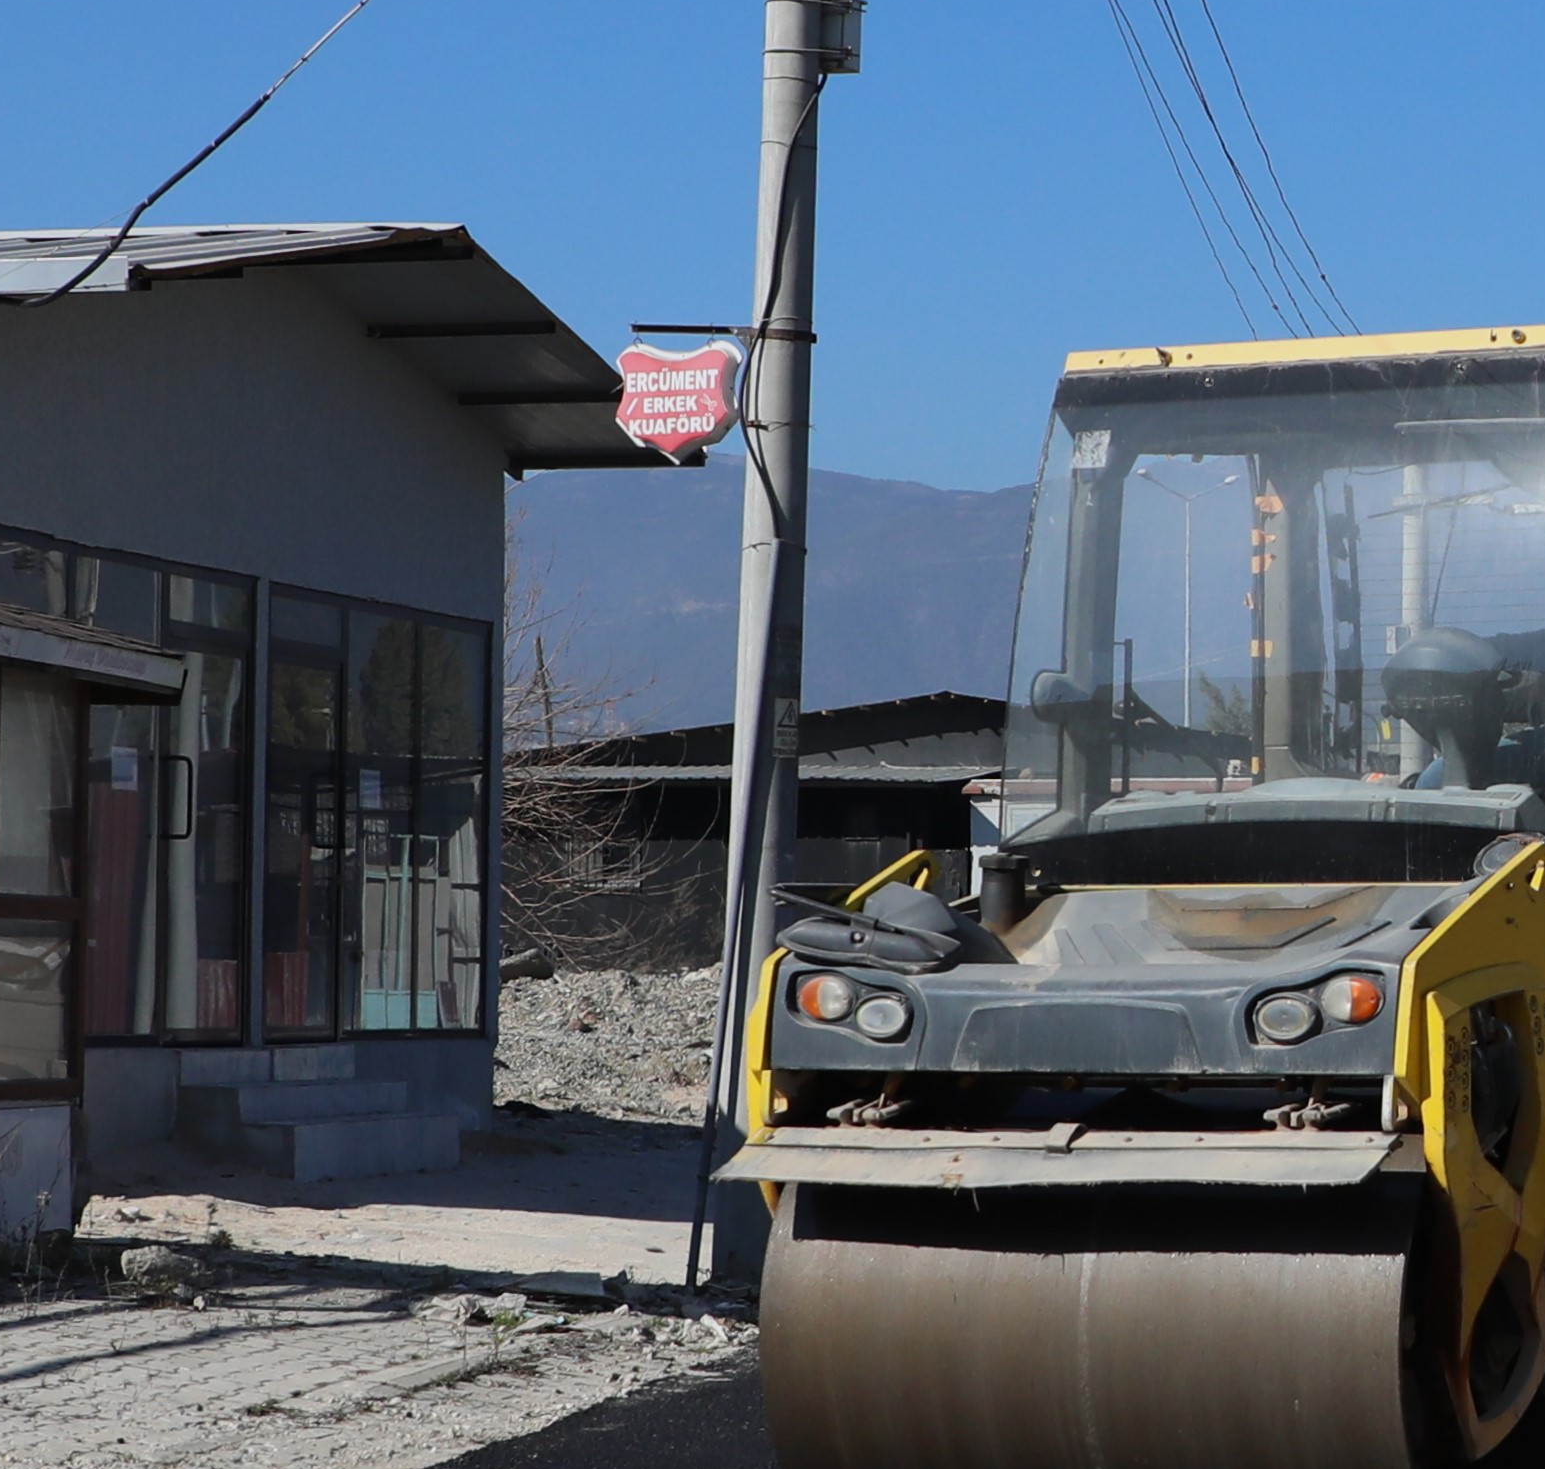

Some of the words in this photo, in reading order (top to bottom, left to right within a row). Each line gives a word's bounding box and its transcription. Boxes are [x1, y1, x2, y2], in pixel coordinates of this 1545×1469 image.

[625, 368, 719, 393] ERCÜMENT
[643, 395, 698, 414] ERKEK
[628, 412, 716, 436] KUAFÖRÜ
